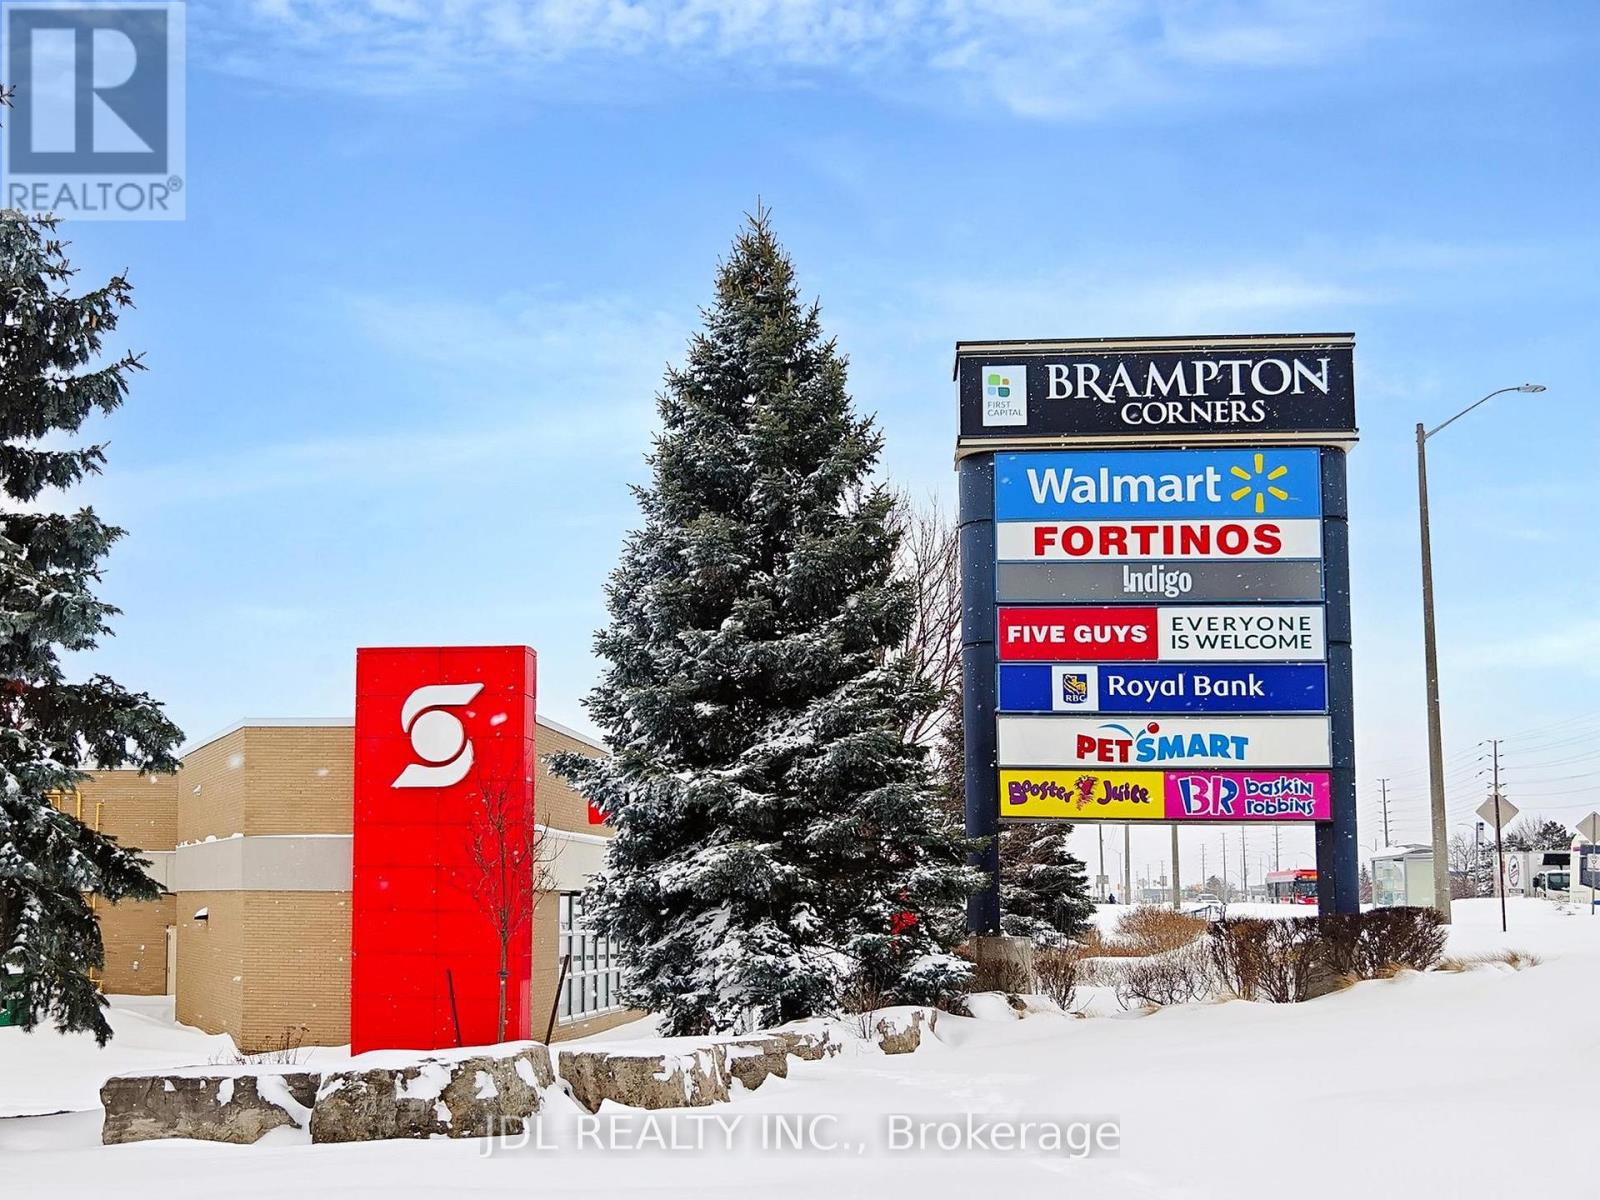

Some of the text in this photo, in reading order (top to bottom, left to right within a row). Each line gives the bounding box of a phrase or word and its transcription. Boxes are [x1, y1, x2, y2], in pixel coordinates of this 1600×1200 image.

[1045, 358, 1330, 403] BRAMPTON
[987, 401, 1010, 409] FIRST
[987, 409, 1023, 417] CAPITAL
[1120, 399, 1265, 425] CORNERS
[1026, 465, 1221, 505] Walmart
[1034, 523, 1282, 556] FORTINOS
[1172, 616, 1311, 631] EVERYONE
[1007, 624, 1148, 643] FIVE GUYS
[1172, 634, 1312, 649] IS WELCOME
[1065, 694, 1087, 702] RBC
[1108, 674, 1265, 703] Royal Bank
[1008, 779, 1150, 805] Booster Juice
[1180, 776, 1238, 815] BR
[1245, 778, 1313, 796] baskin
[1245, 797, 1315, 816] robbins
